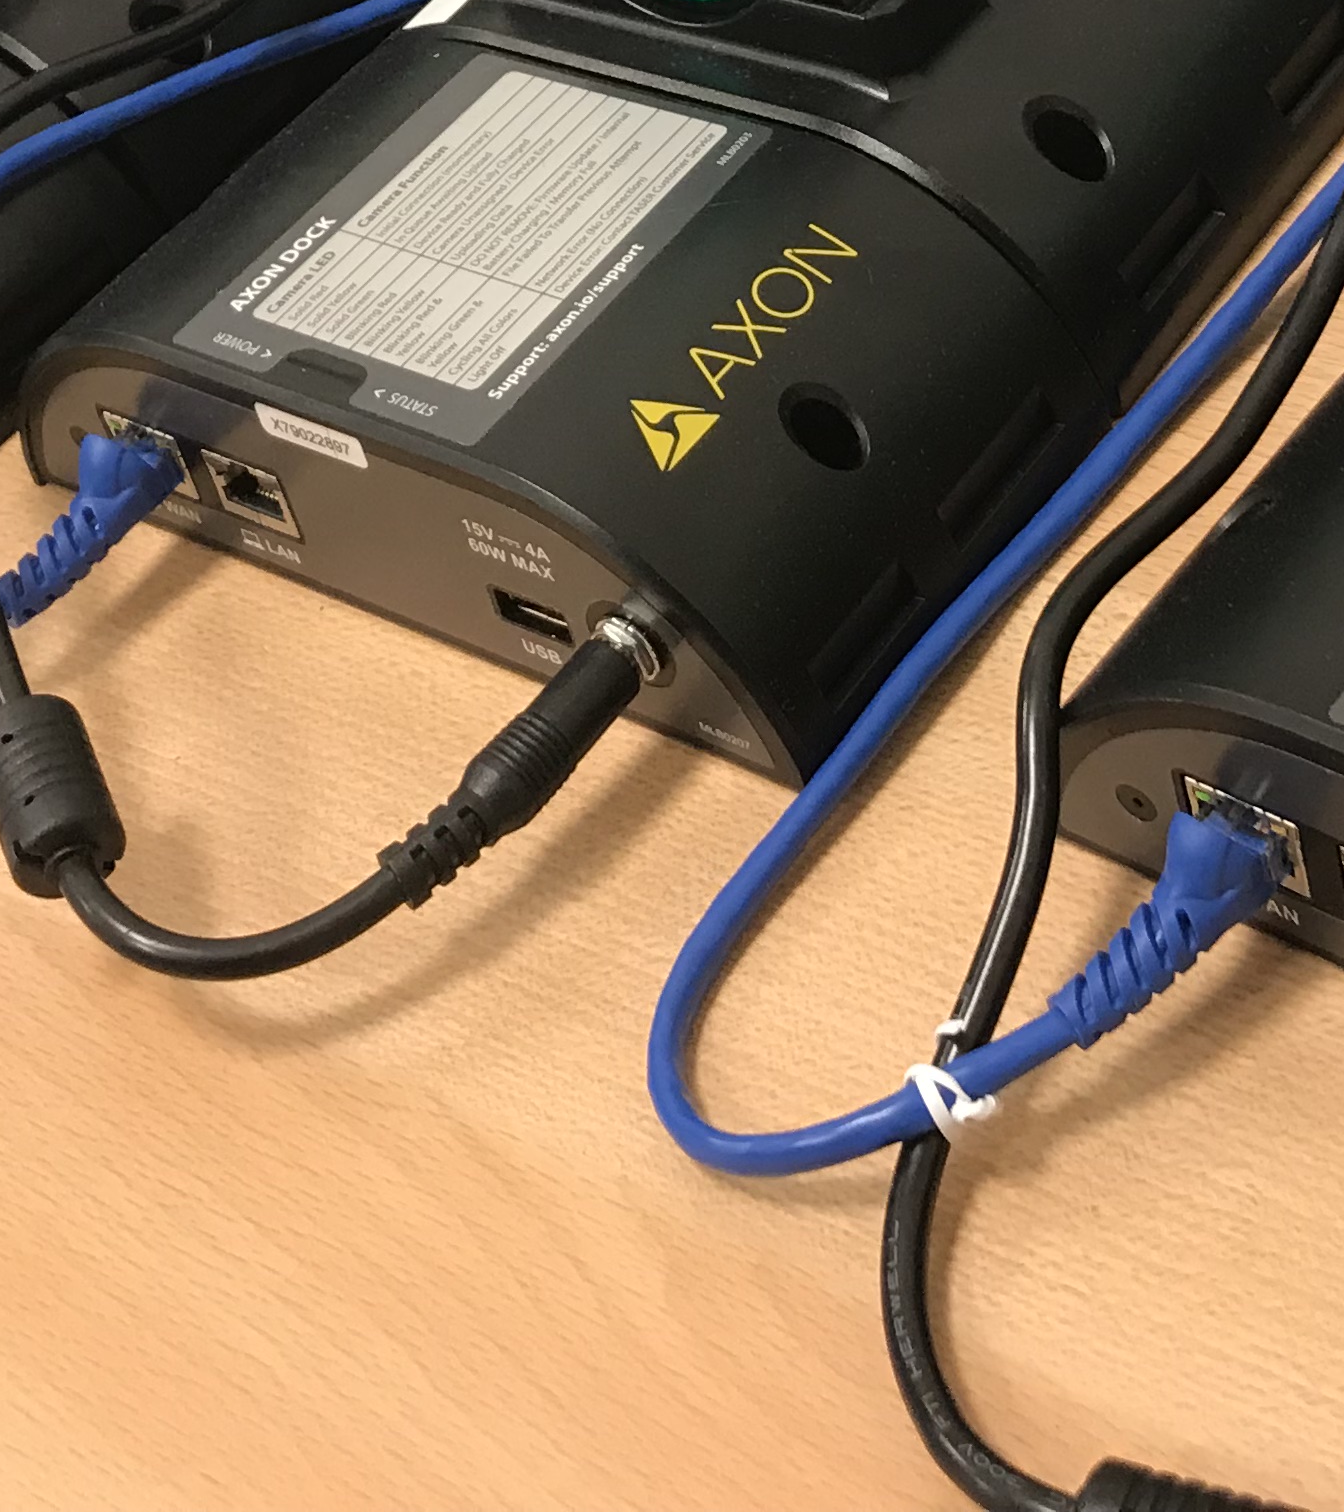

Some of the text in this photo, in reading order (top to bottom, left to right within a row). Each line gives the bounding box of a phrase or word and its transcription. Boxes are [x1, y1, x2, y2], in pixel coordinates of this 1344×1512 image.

[356, 145, 448, 227] Camera Function
[449, 204, 513, 260] Uploading Data
[229, 216, 336, 311] AXON DOCK
[266, 251, 335, 313] Camera LED
[487, 243, 644, 399] Support: axon.io/support
[689, 223, 861, 399] AXON
[212, 331, 260, 355] POWER
[447, 308, 518, 375] Cycling All Colors
[466, 344, 506, 382] Light Off
[386, 392, 438, 416] STATUS
[265, 539, 301, 564] LAN
[462, 518, 551, 564] 15V 4A
[468, 537, 556, 582] 60W MAX
[521, 637, 563, 665] USB
[1256, 899, 1301, 926] AN
